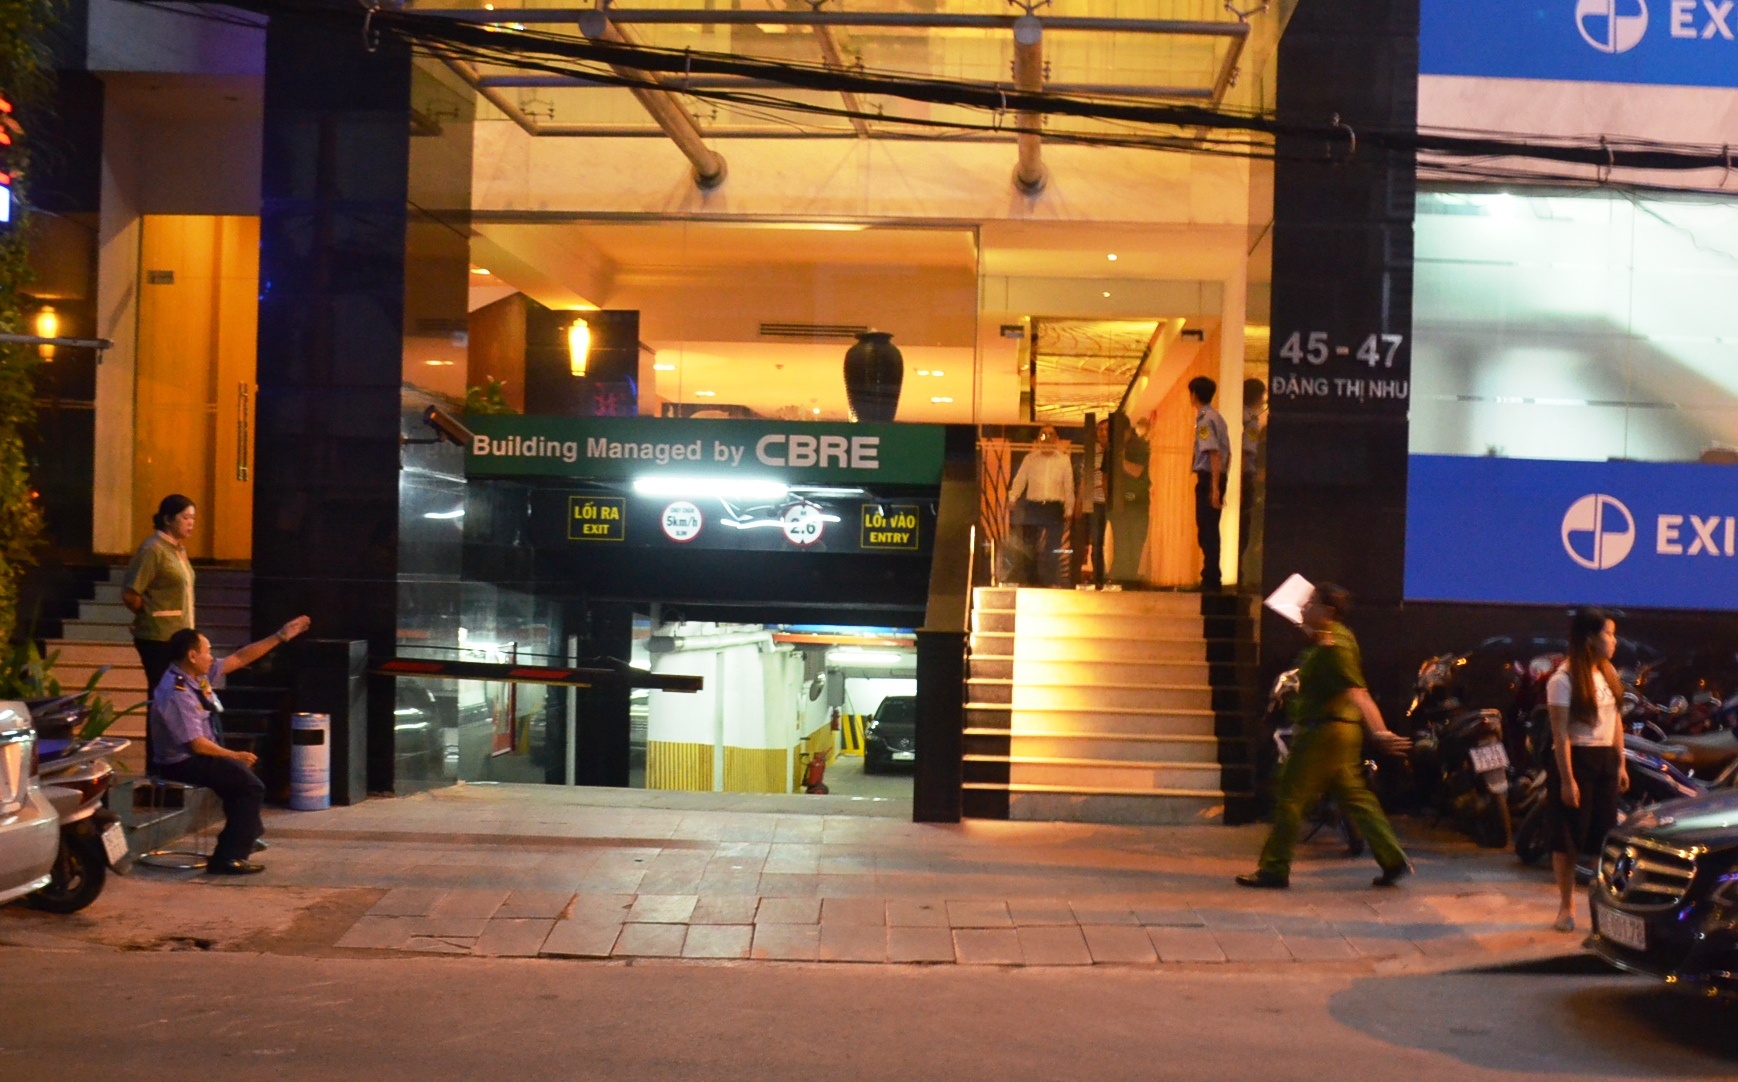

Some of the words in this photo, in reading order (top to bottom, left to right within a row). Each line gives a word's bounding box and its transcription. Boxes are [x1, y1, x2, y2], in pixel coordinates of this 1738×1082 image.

[1271, 373, 1330, 400] ĐẶNG
[1333, 379, 1366, 403] THỊ
[1369, 380, 1409, 400] NHU
[472, 435, 578, 463] Building
[586, 438, 702, 466] Managed
[714, 440, 745, 467] by
[755, 434, 880, 469] CBRE
[574, 501, 598, 519] LỐI
[601, 506, 620, 520] RA
[582, 523, 611, 535] EXIT
[869, 532, 910, 544] ENTRY
[1656, 514, 1736, 557] EXI
